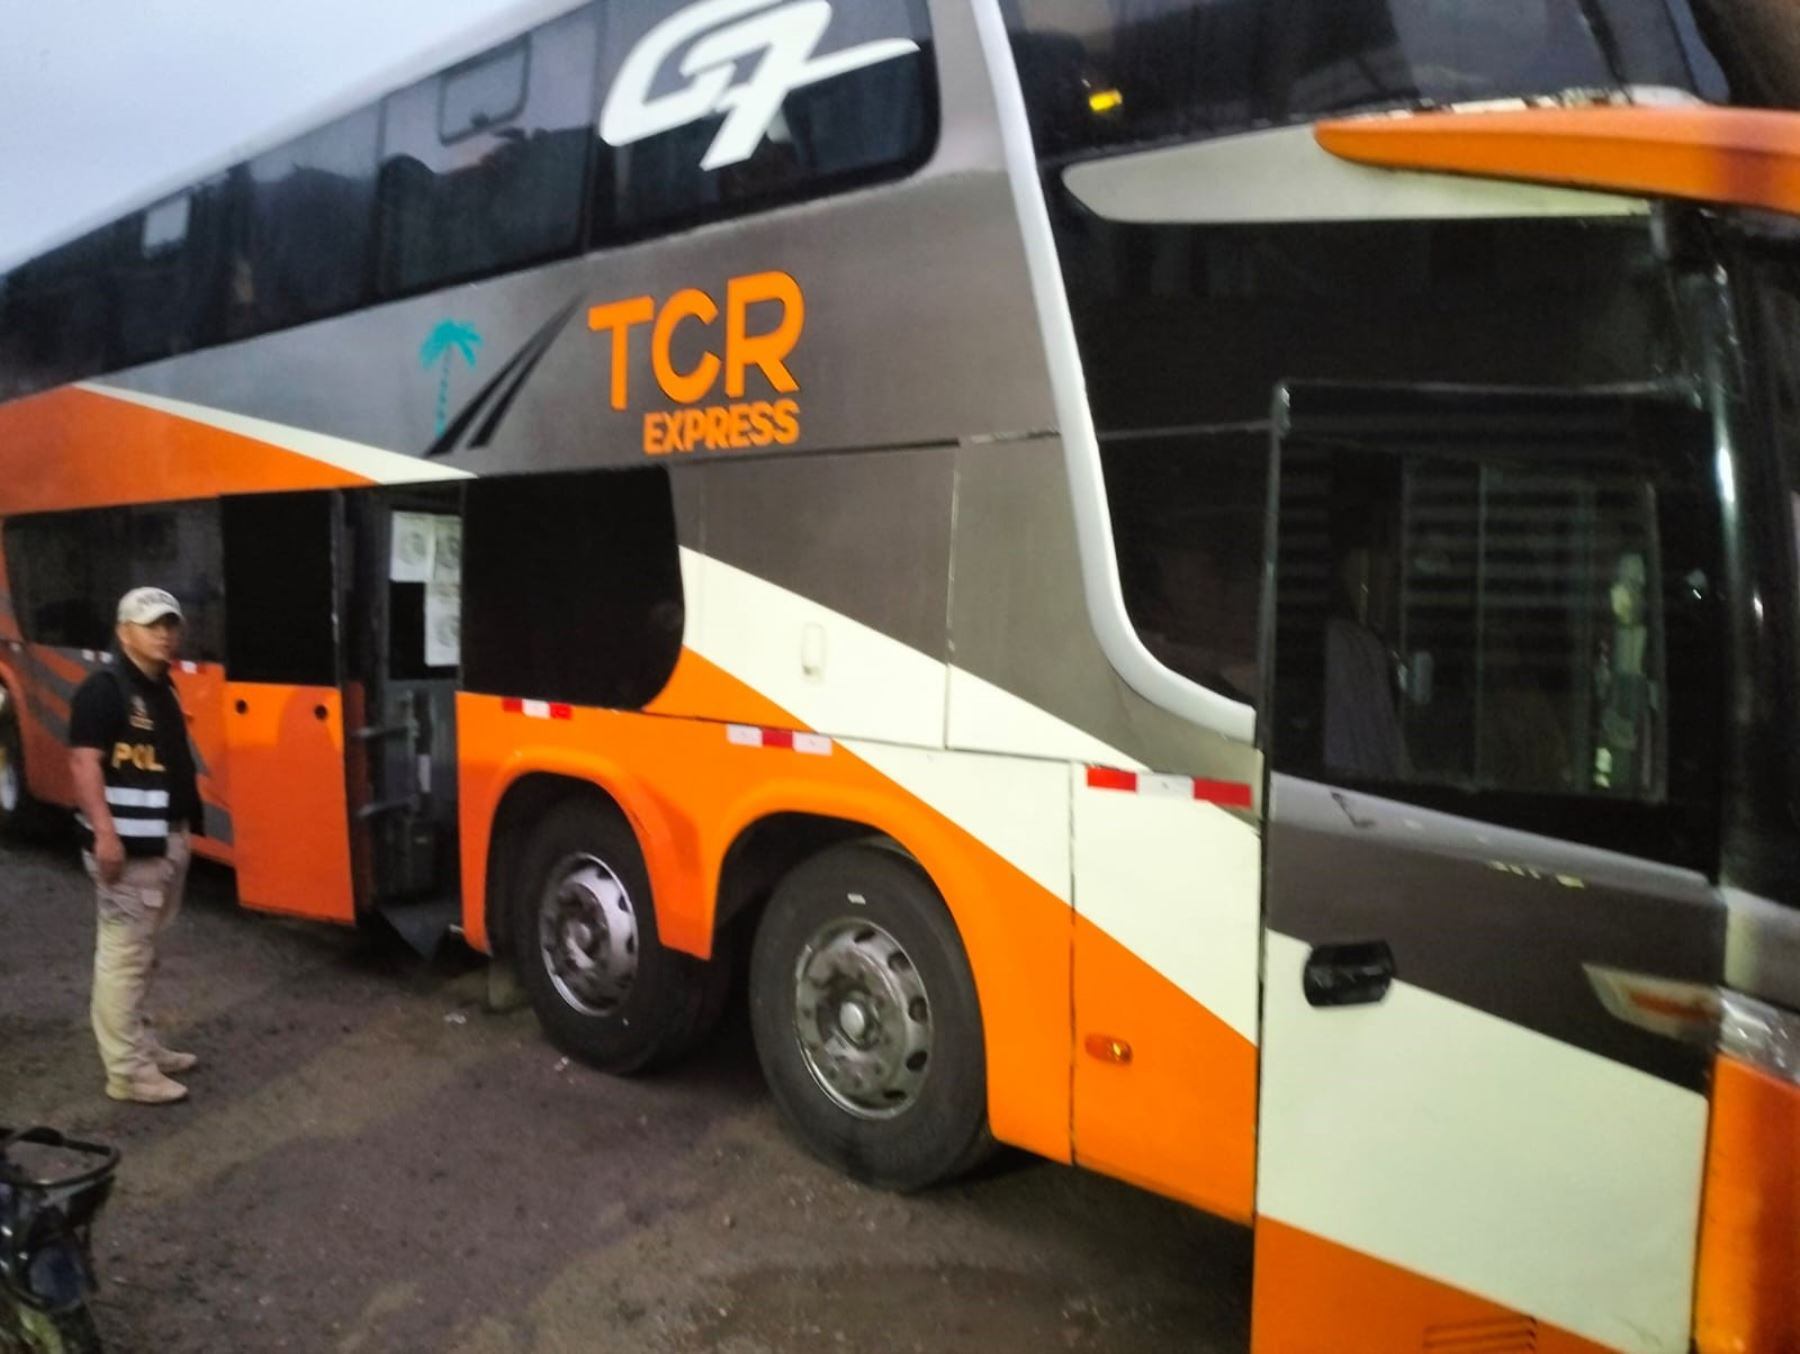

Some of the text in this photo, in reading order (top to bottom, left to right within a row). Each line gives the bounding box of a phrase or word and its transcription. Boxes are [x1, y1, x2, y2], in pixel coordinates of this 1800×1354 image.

[600, 0, 921, 172] G7
[588, 271, 804, 411] TCR
[643, 398, 799, 455] EXPRESS
